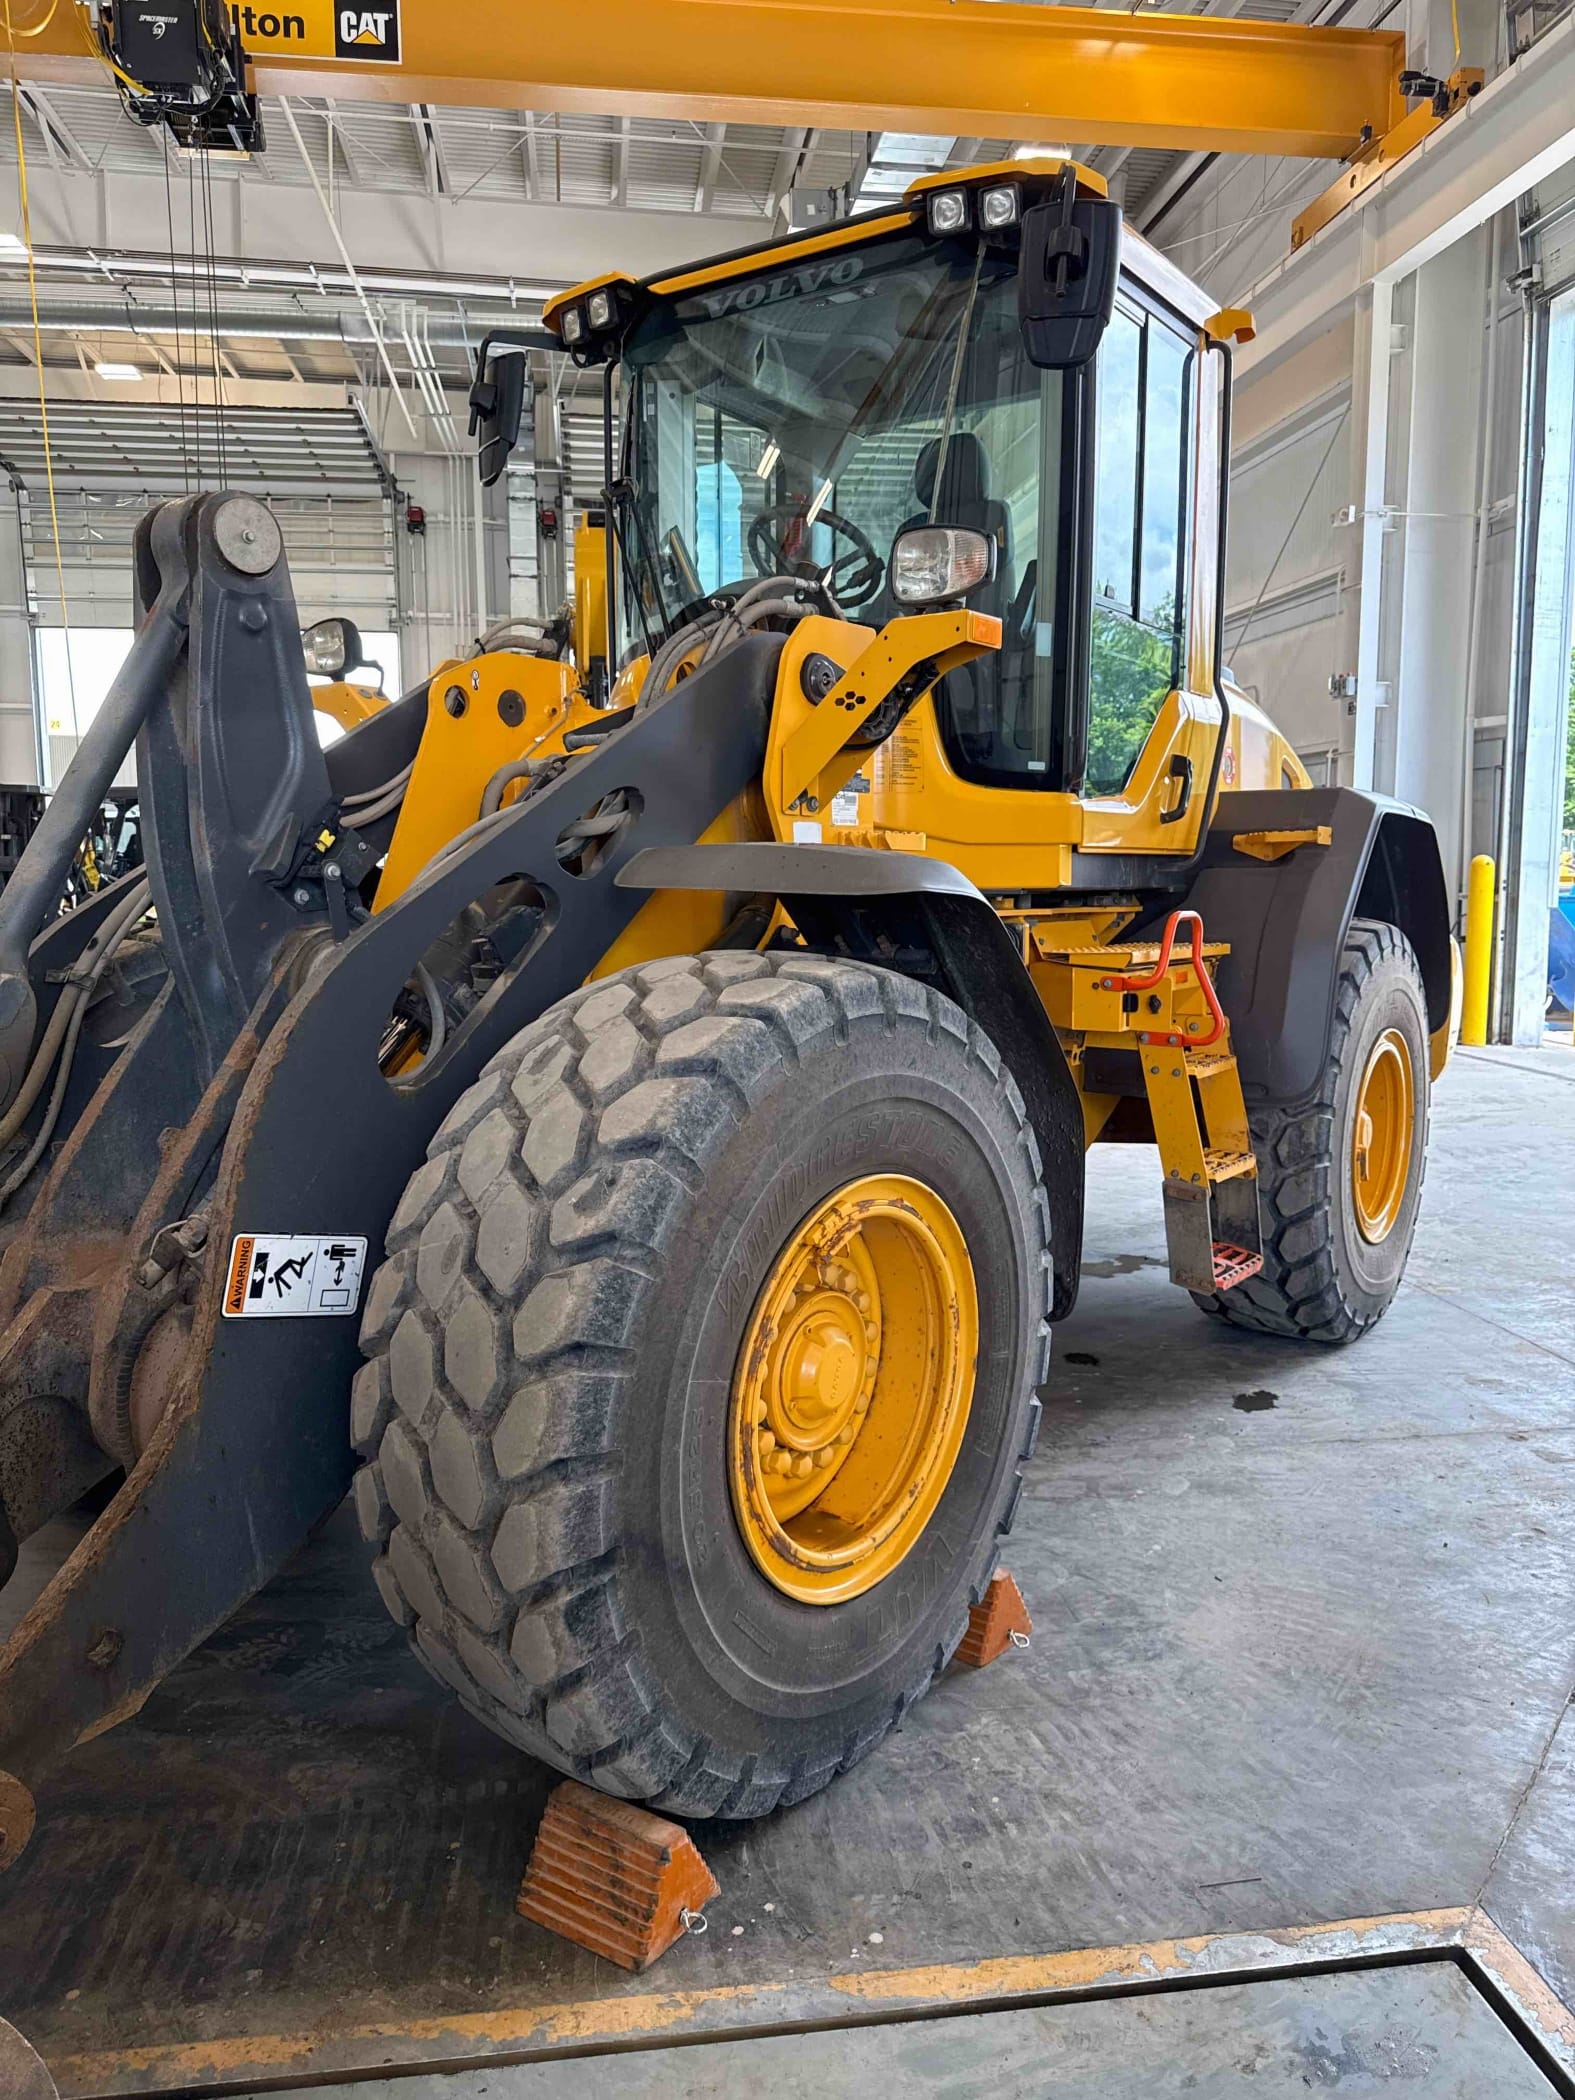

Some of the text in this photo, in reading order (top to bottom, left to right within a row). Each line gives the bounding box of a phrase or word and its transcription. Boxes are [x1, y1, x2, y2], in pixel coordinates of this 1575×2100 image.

[231, 4, 305, 39] lton
[340, 11, 390, 45] CAT
[702, 257, 864, 319] VOLVO
[233, 1240, 252, 1297] WARNING
